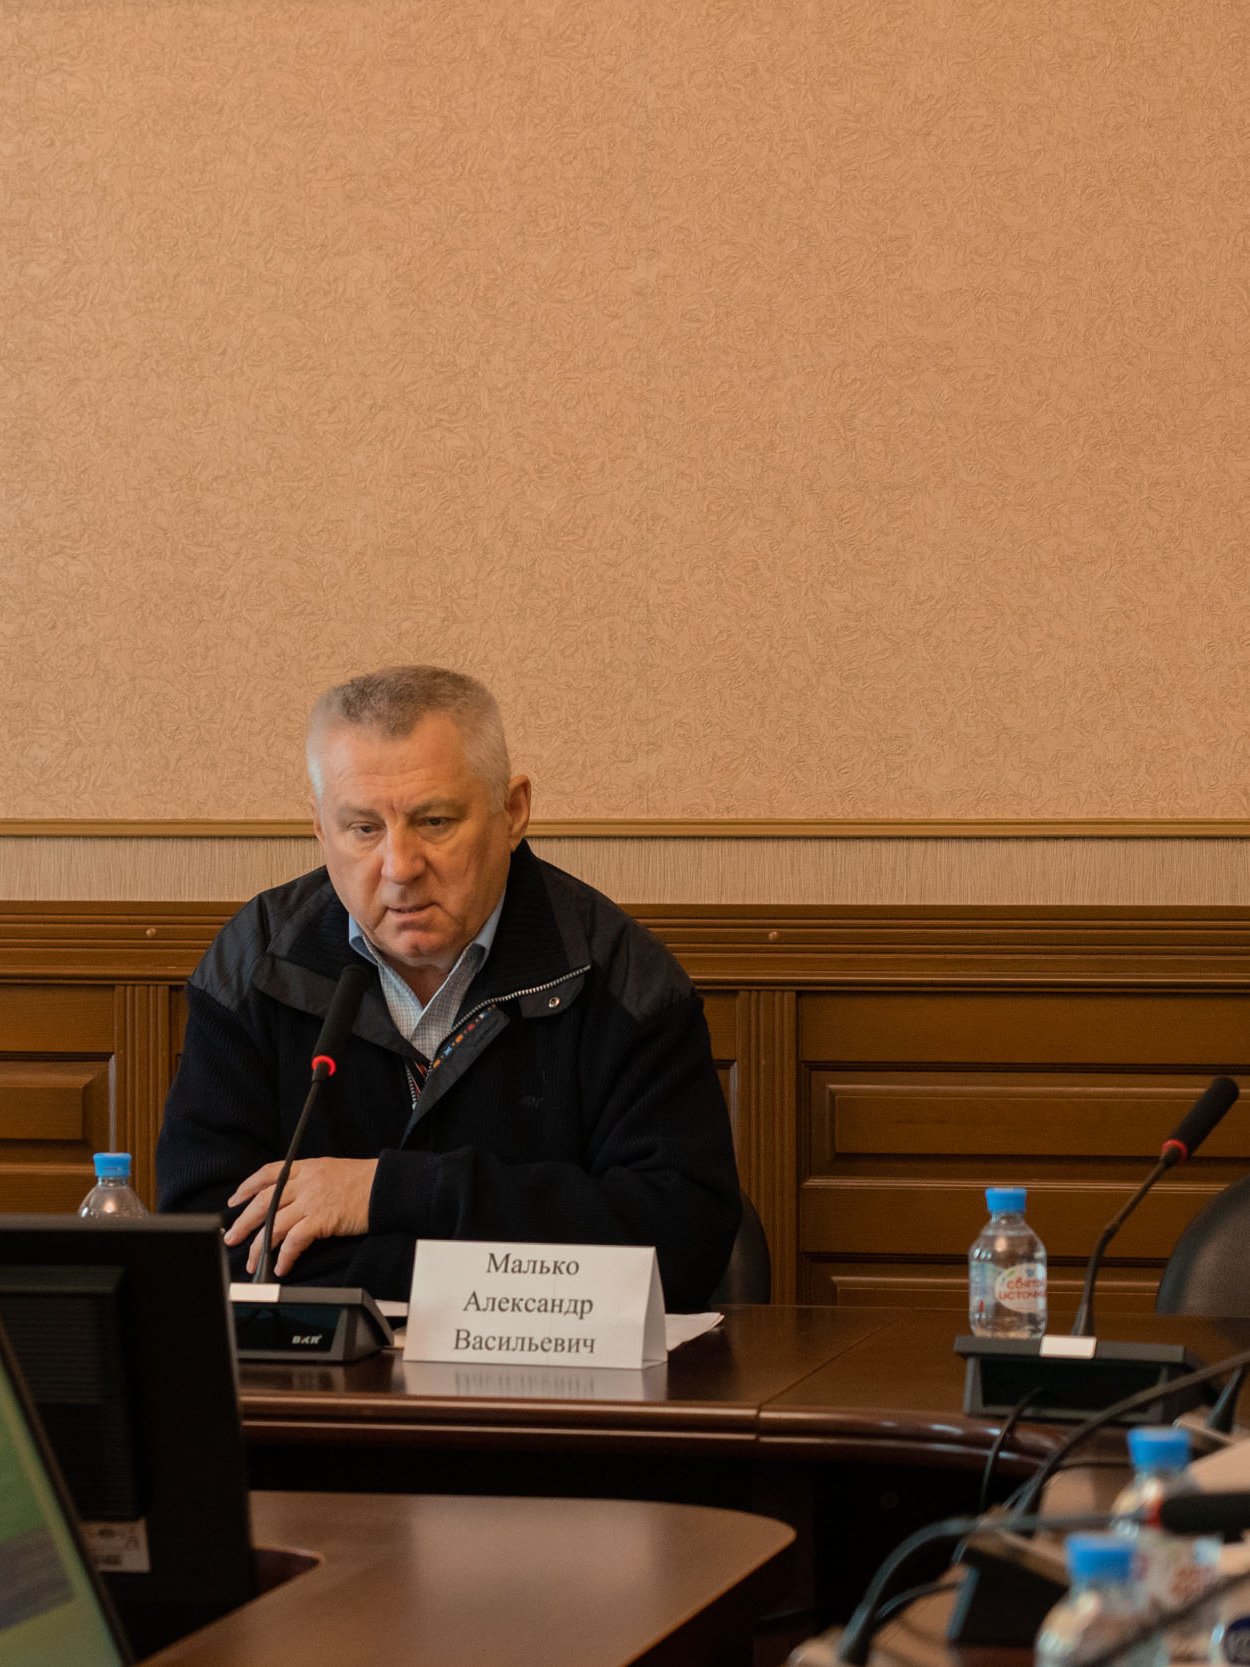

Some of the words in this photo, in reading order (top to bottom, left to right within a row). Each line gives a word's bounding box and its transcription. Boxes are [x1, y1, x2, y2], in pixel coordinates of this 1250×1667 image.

[485, 1252, 580, 1276] Малько
[462, 1290, 594, 1320] Александр
[453, 1328, 597, 1354] Васильевич
